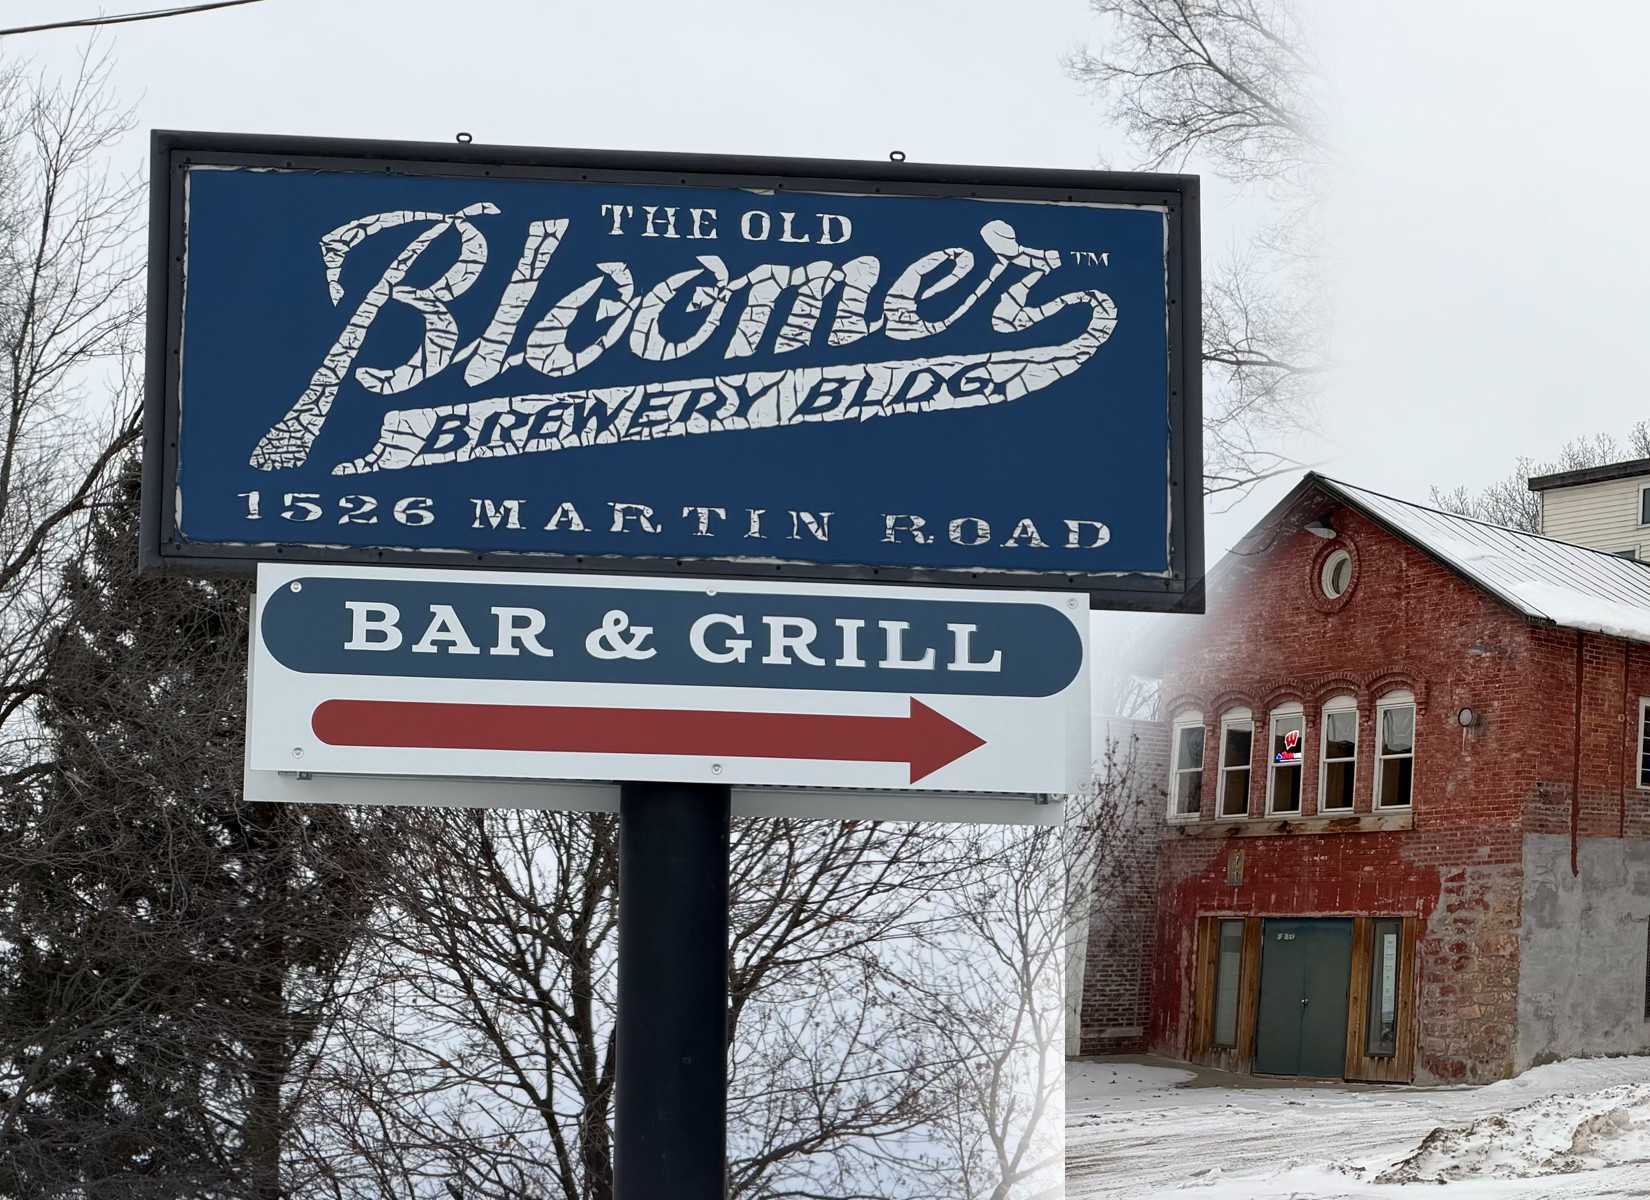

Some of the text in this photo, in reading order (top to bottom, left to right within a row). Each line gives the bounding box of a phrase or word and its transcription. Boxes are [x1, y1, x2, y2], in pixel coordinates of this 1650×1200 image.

[600, 203, 854, 245] THE OLD
[1070, 250, 1110, 268] TM
[249, 201, 1118, 471] Bloomer
[415, 369, 790, 456] BREWERY
[237, 490, 1112, 549] 1526 MARTIN ROAD
[343, 600, 1003, 673] BAR & GRILL
